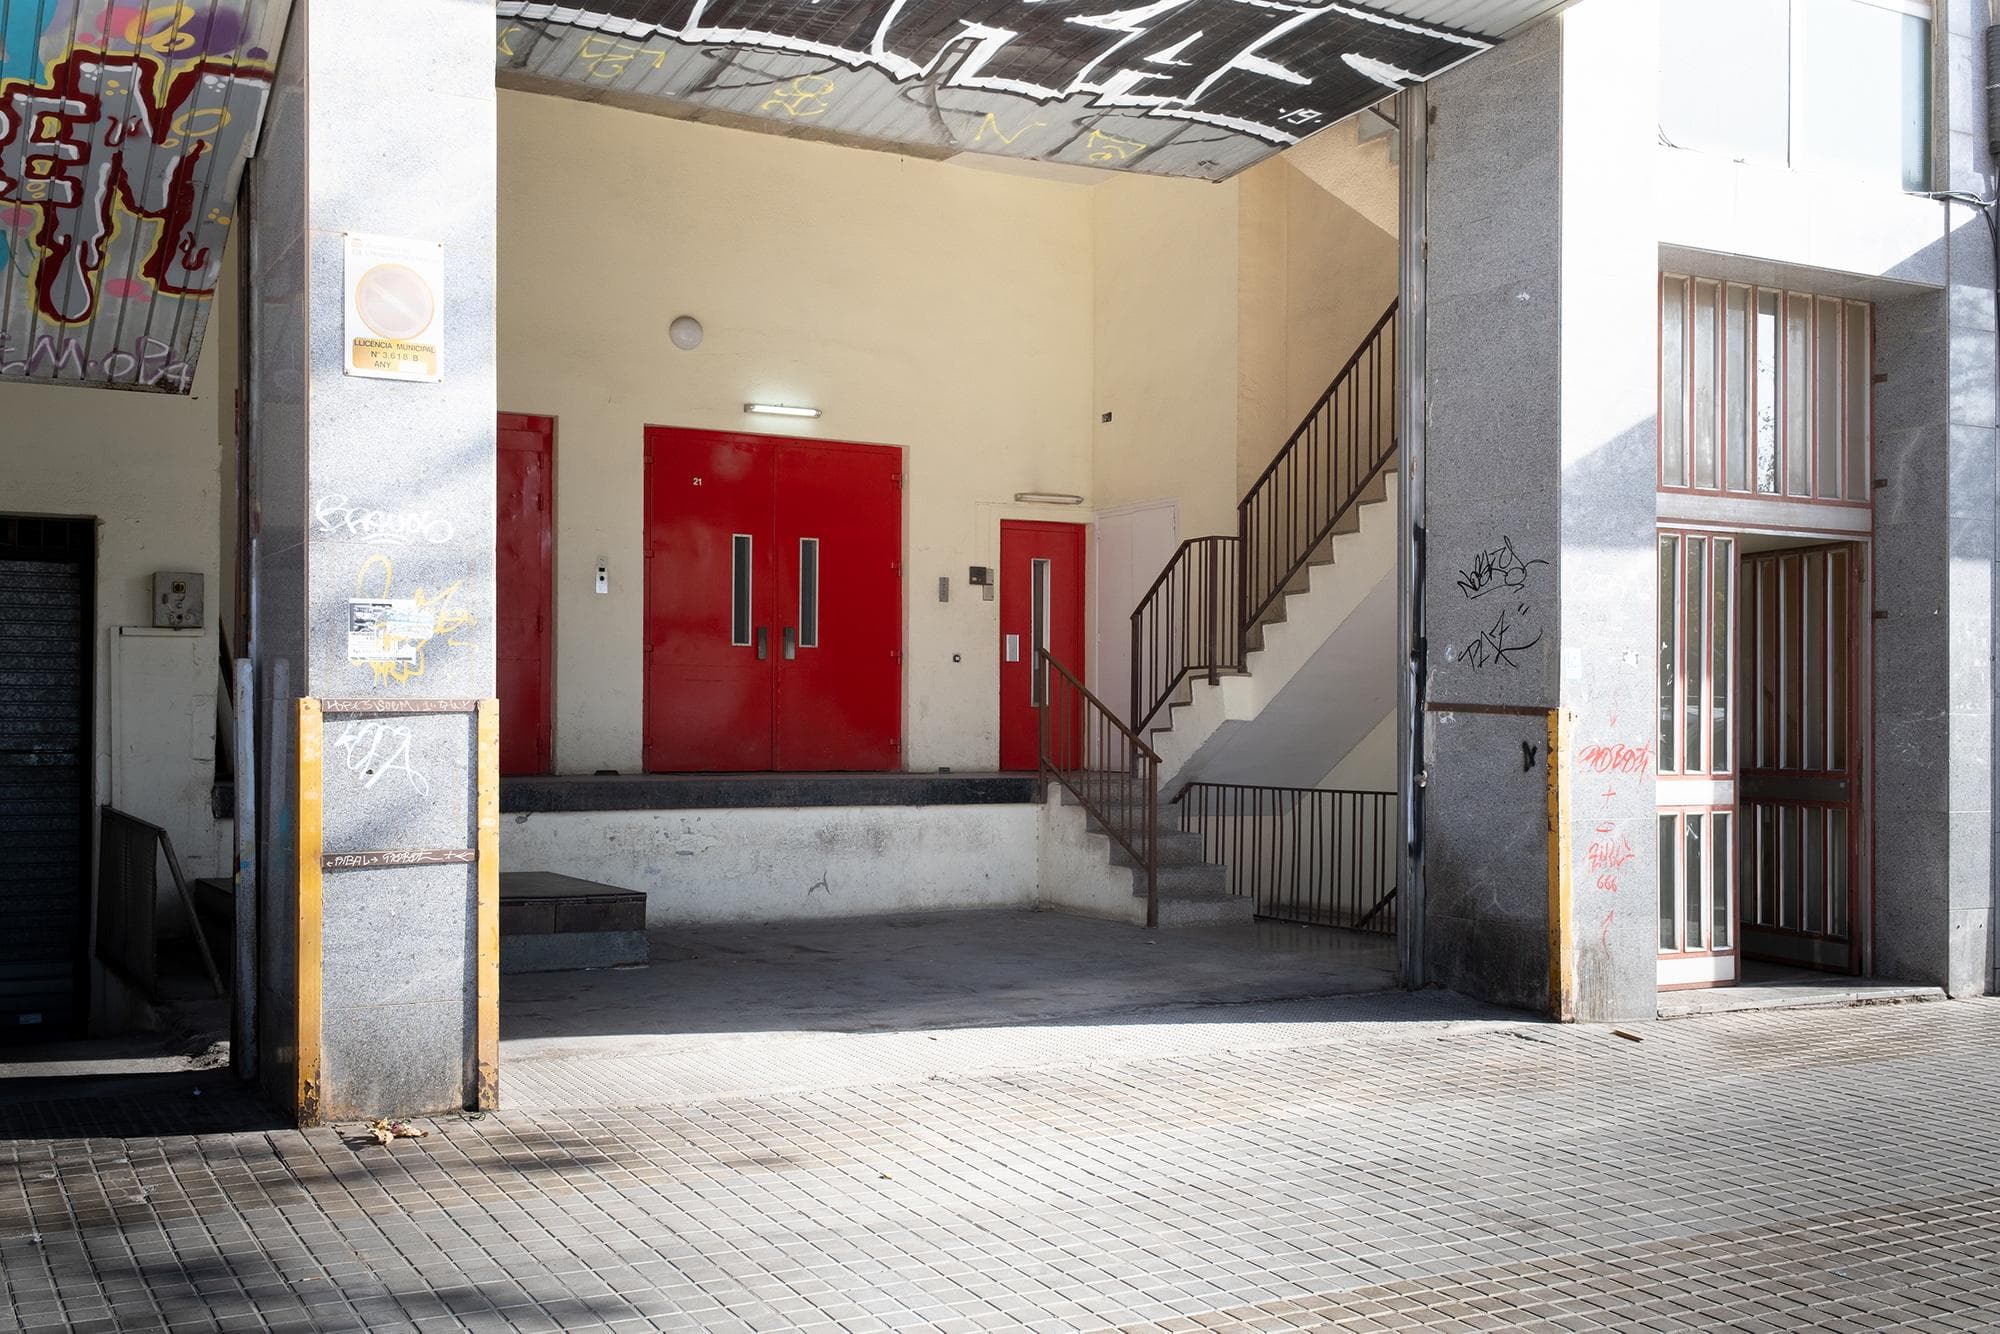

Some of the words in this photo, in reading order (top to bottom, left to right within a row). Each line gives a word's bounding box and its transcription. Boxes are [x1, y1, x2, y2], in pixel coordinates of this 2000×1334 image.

[354, 339, 393, 349] LLICENCIA
[396, 343, 437, 354] MUNICIPAL
[374, 360, 391, 369] ANY
[693, 477, 702, 486] 21
